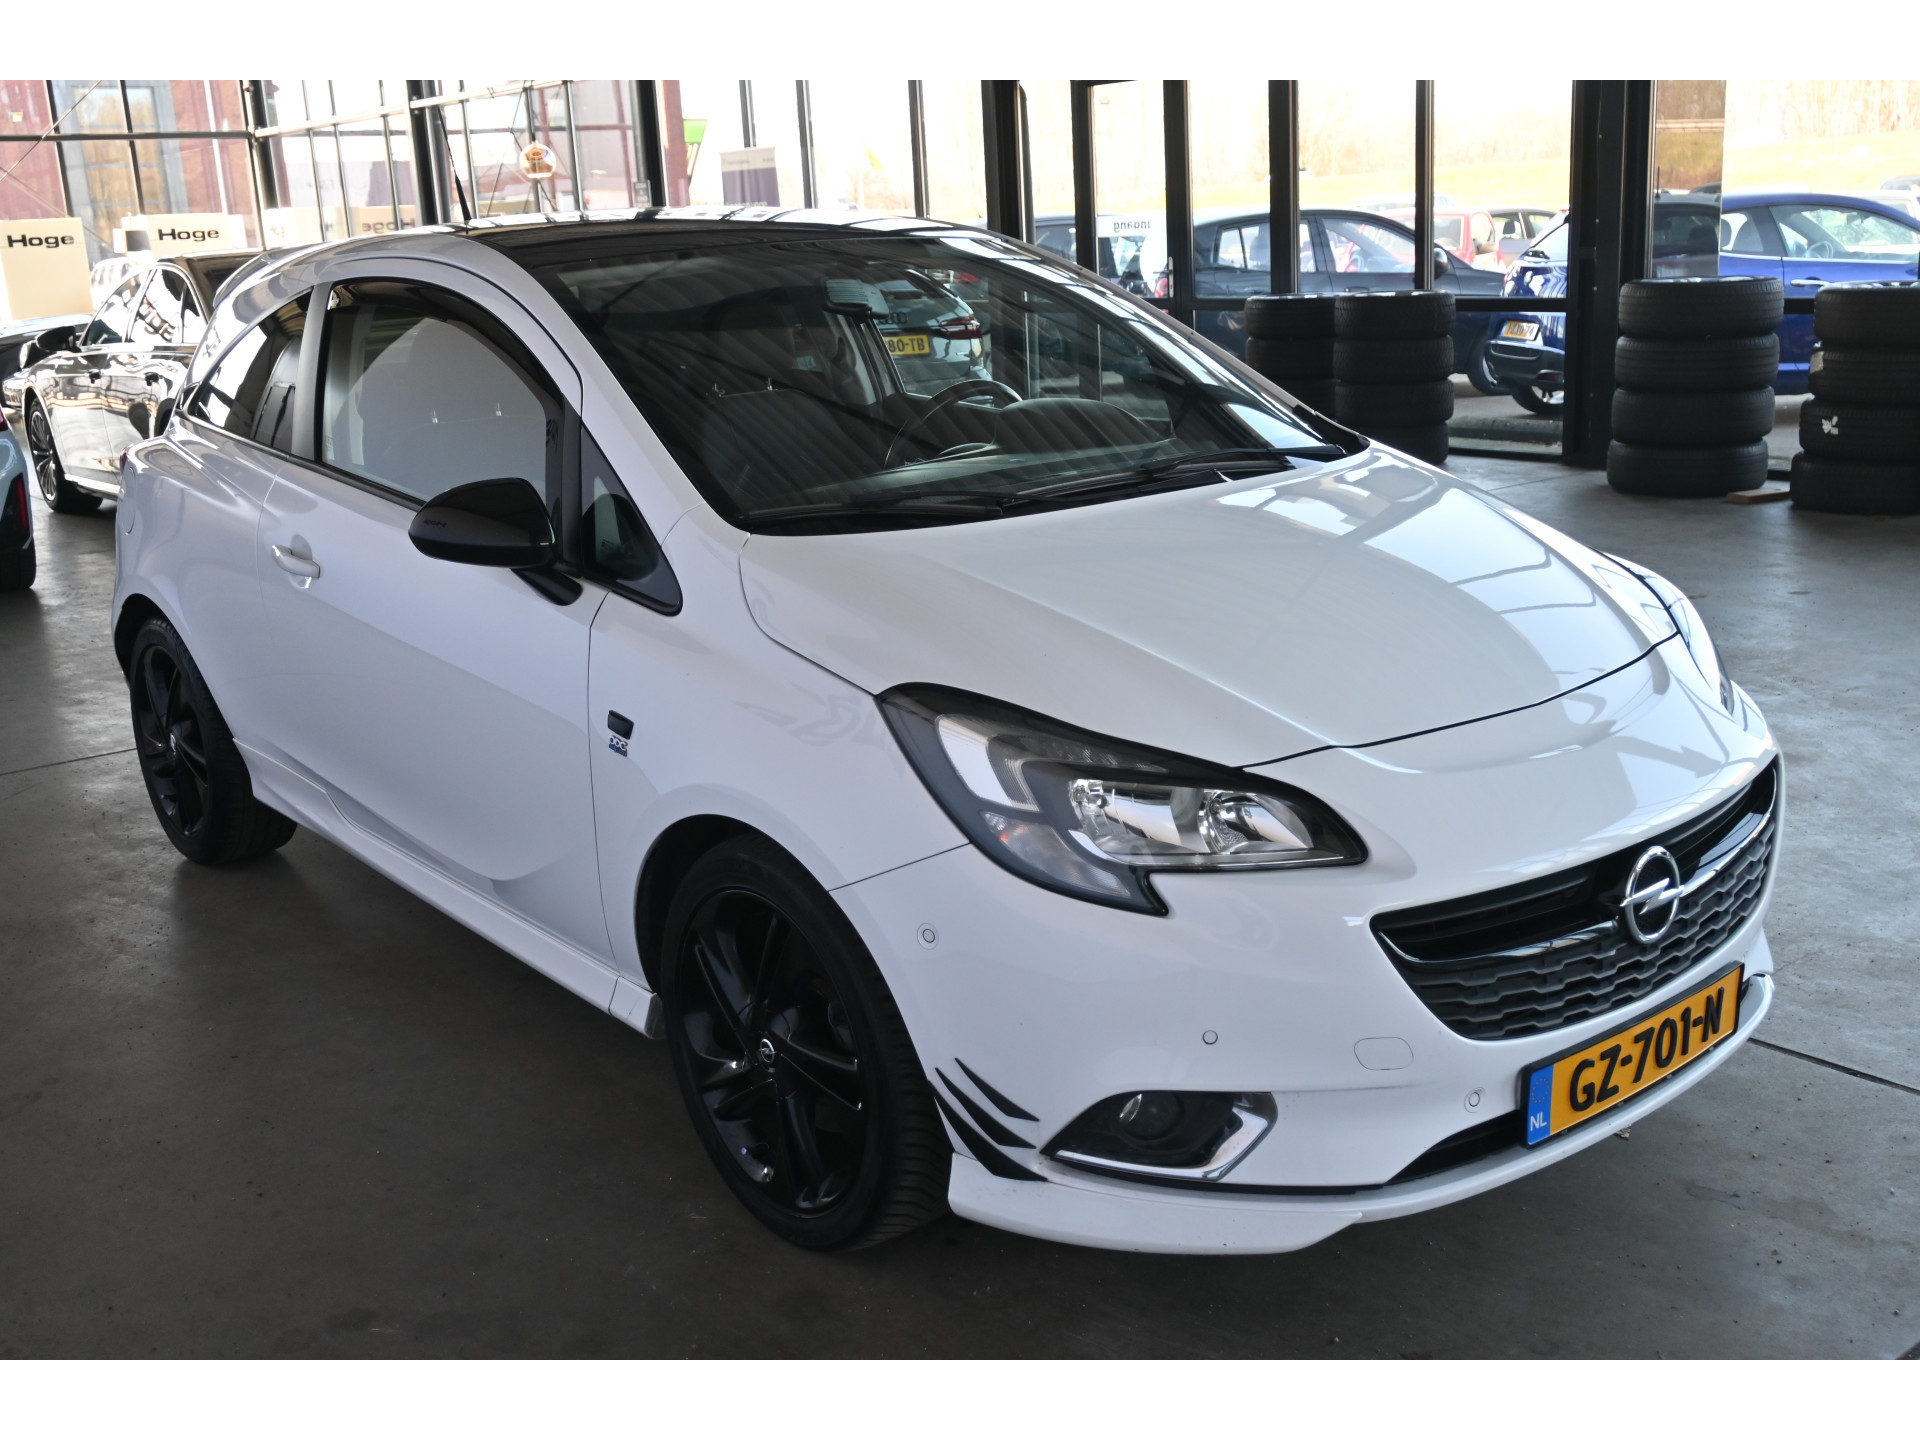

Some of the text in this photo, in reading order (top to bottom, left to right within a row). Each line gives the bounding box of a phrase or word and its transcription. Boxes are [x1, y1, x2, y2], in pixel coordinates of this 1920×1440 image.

[7, 234, 75, 249] Hoge
[157, 227, 220, 242] Hoge
[885, 337, 926, 353] 80-TB
[1569, 986, 1725, 1112] GZ-701-N
[1530, 1111, 1548, 1132] NL
